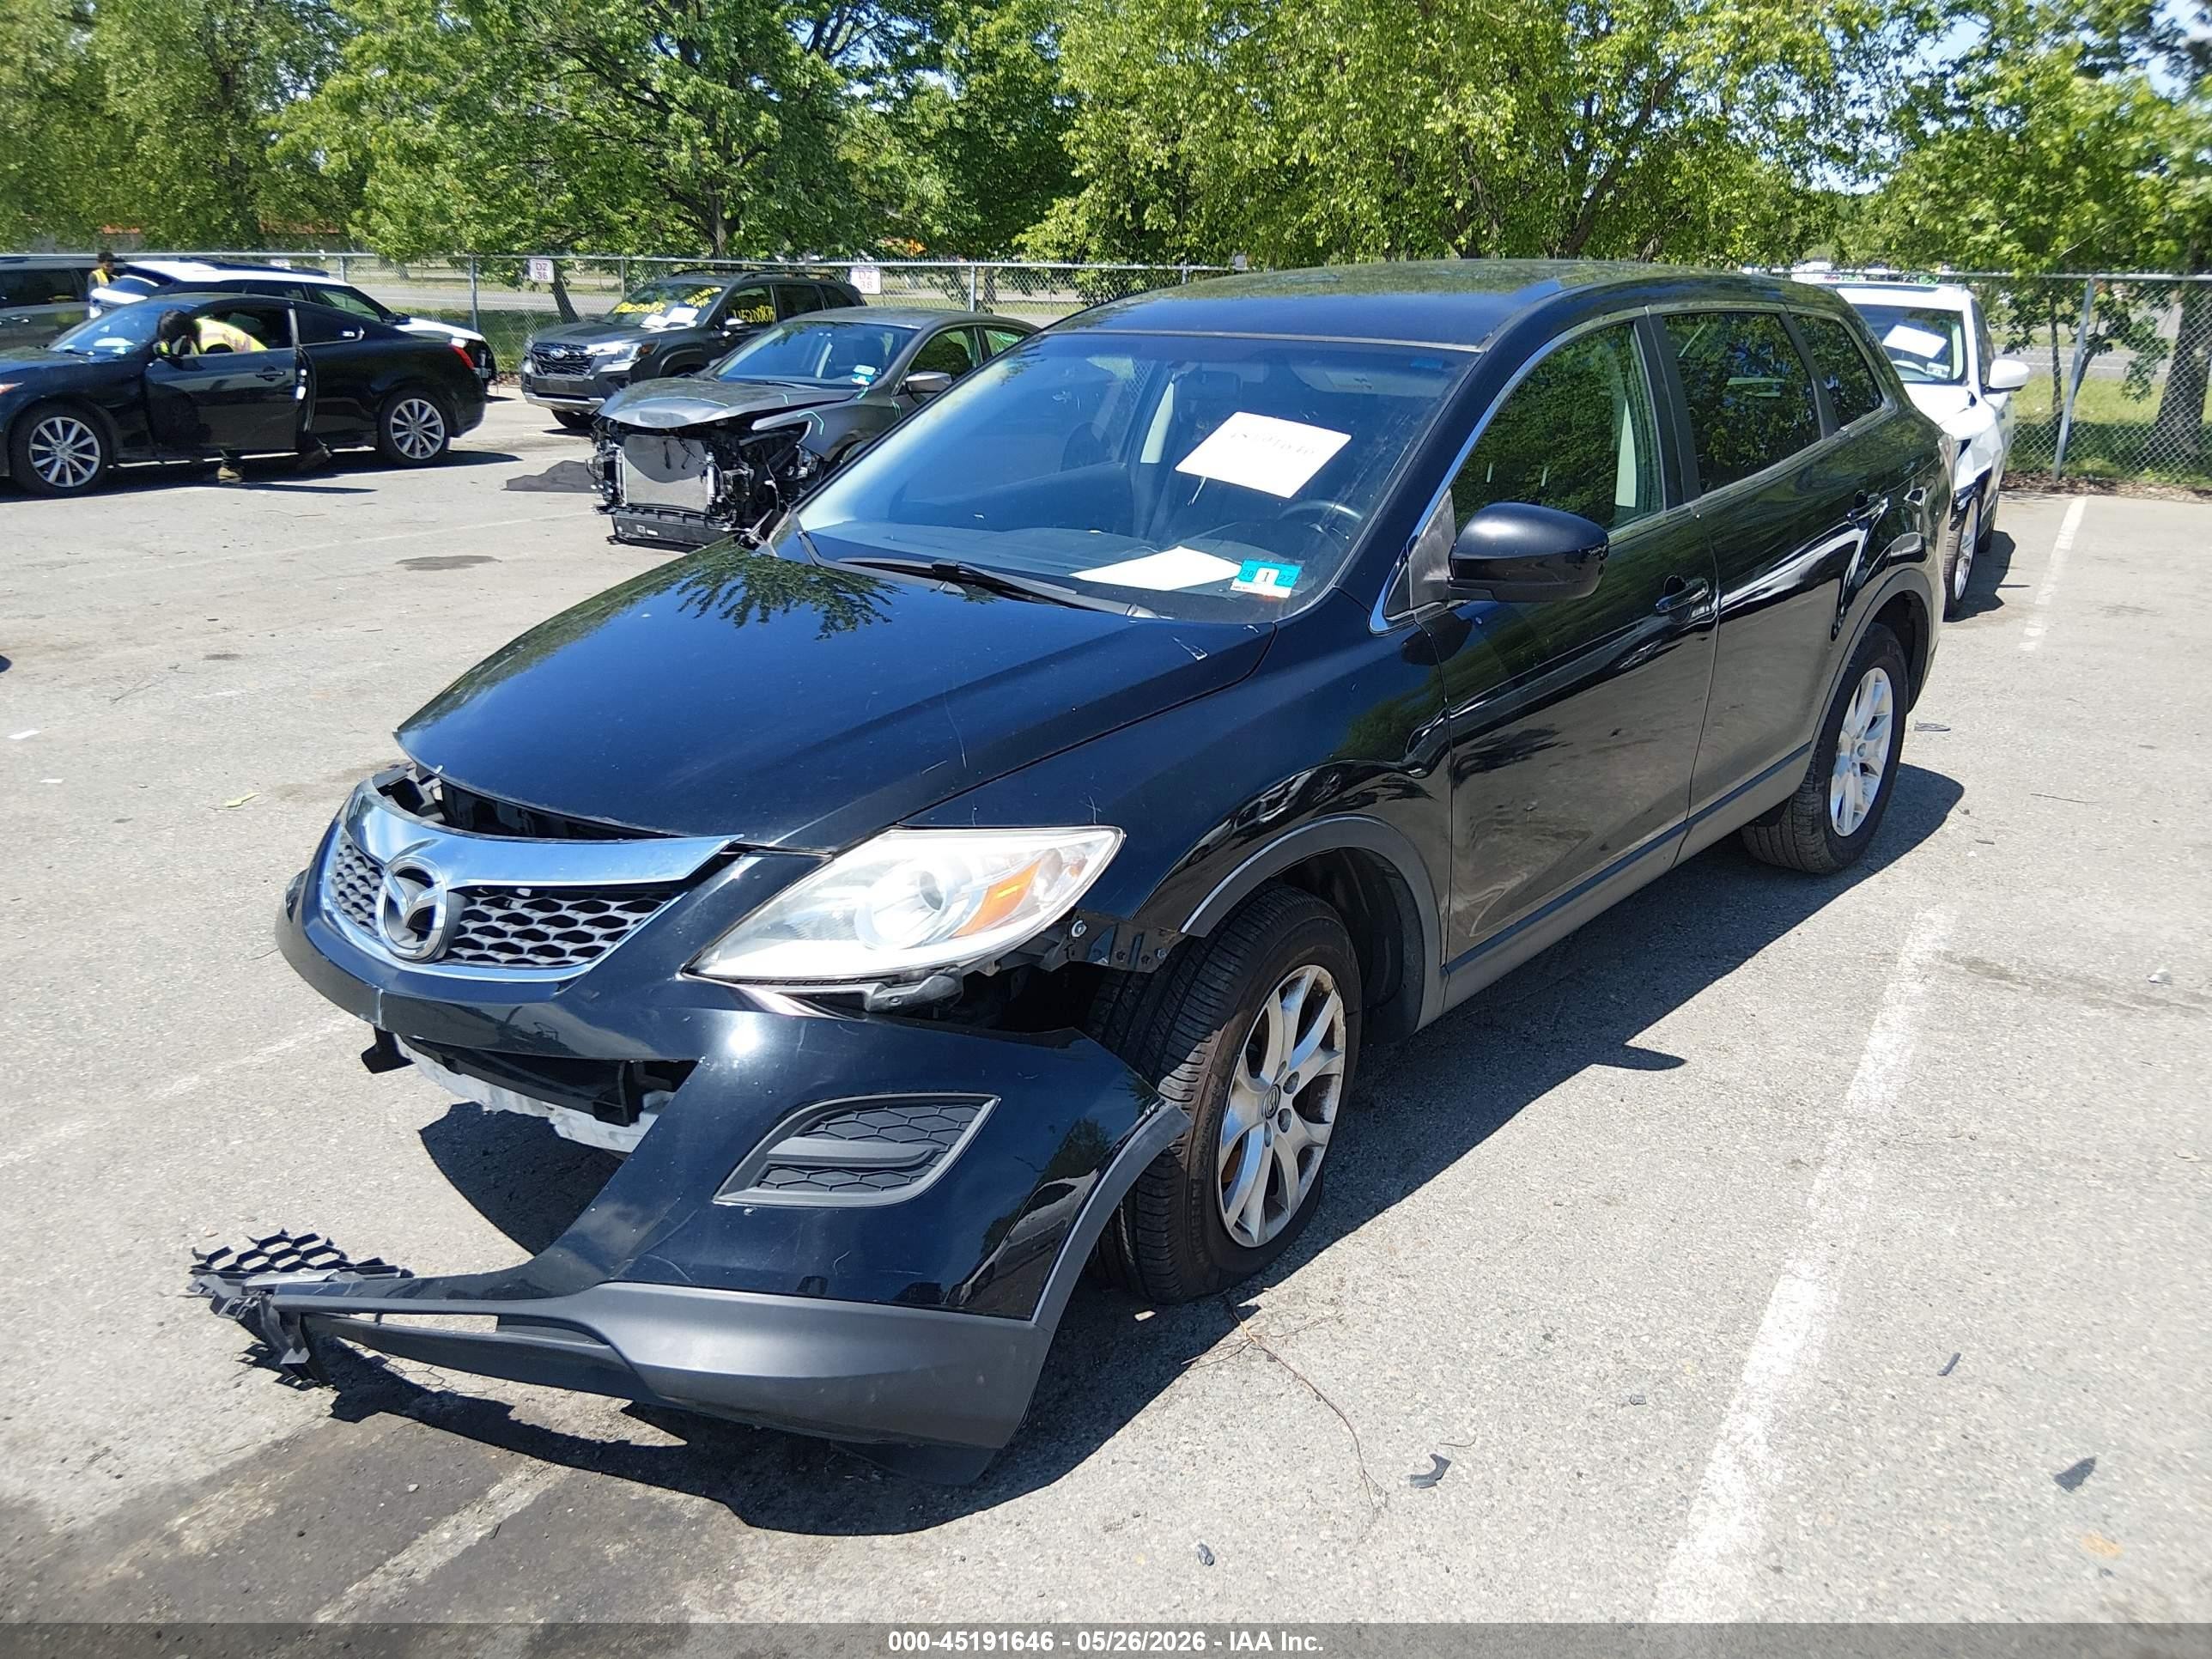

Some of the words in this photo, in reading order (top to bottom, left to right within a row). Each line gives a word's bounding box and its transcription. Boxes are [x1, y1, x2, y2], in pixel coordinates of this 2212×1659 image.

[537, 271, 549, 280] 36
[1242, 569, 1255, 578] 20
[1262, 571, 1270, 583] 1
[1279, 574, 1293, 583] 27
